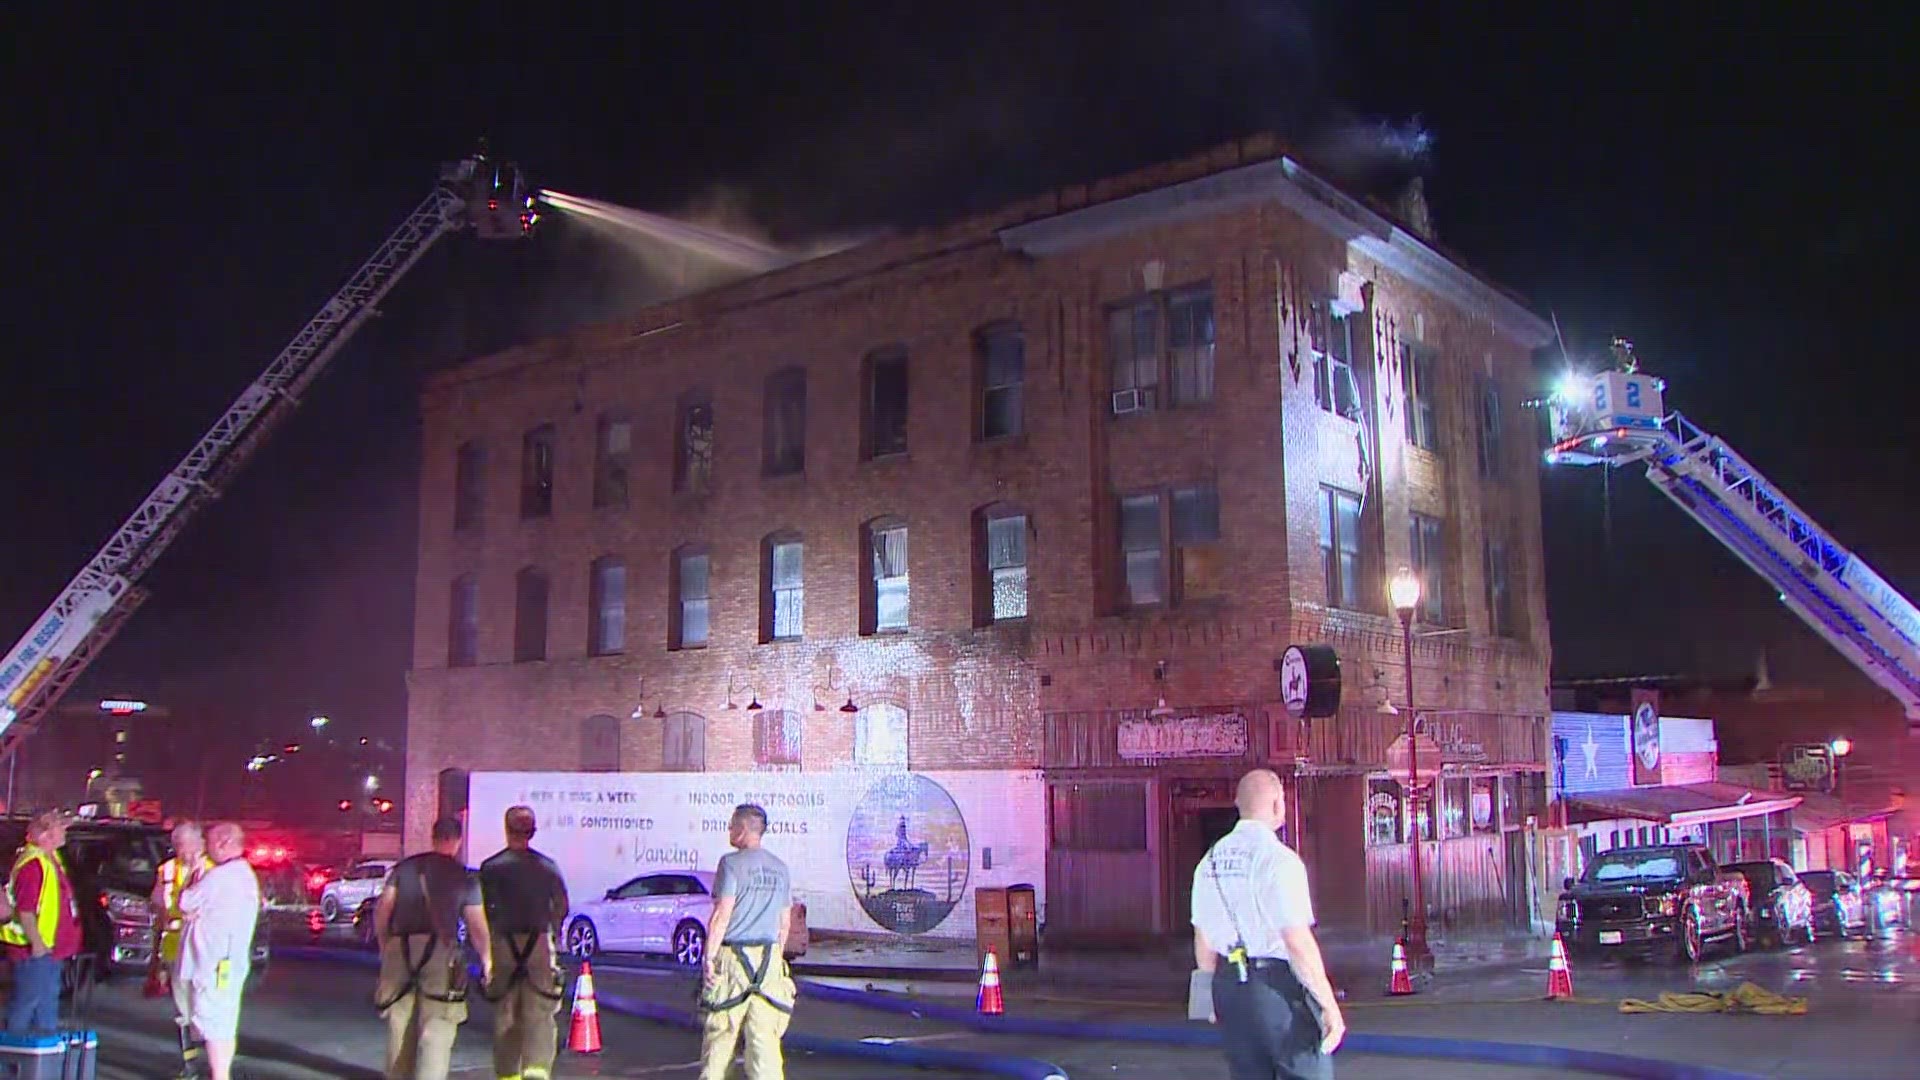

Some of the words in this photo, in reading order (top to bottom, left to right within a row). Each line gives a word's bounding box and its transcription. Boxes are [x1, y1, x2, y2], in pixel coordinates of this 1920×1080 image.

[1595, 384, 1607, 411] 2
[1626, 381, 1641, 408] 2
[606, 790, 637, 804] WEEK
[688, 791, 735, 806] INDOOR
[744, 791, 825, 807] RESTROOMS
[580, 816, 654, 831] CONDITIONED
[701, 818, 731, 833] DRI
[633, 836, 699, 871] Dancing
